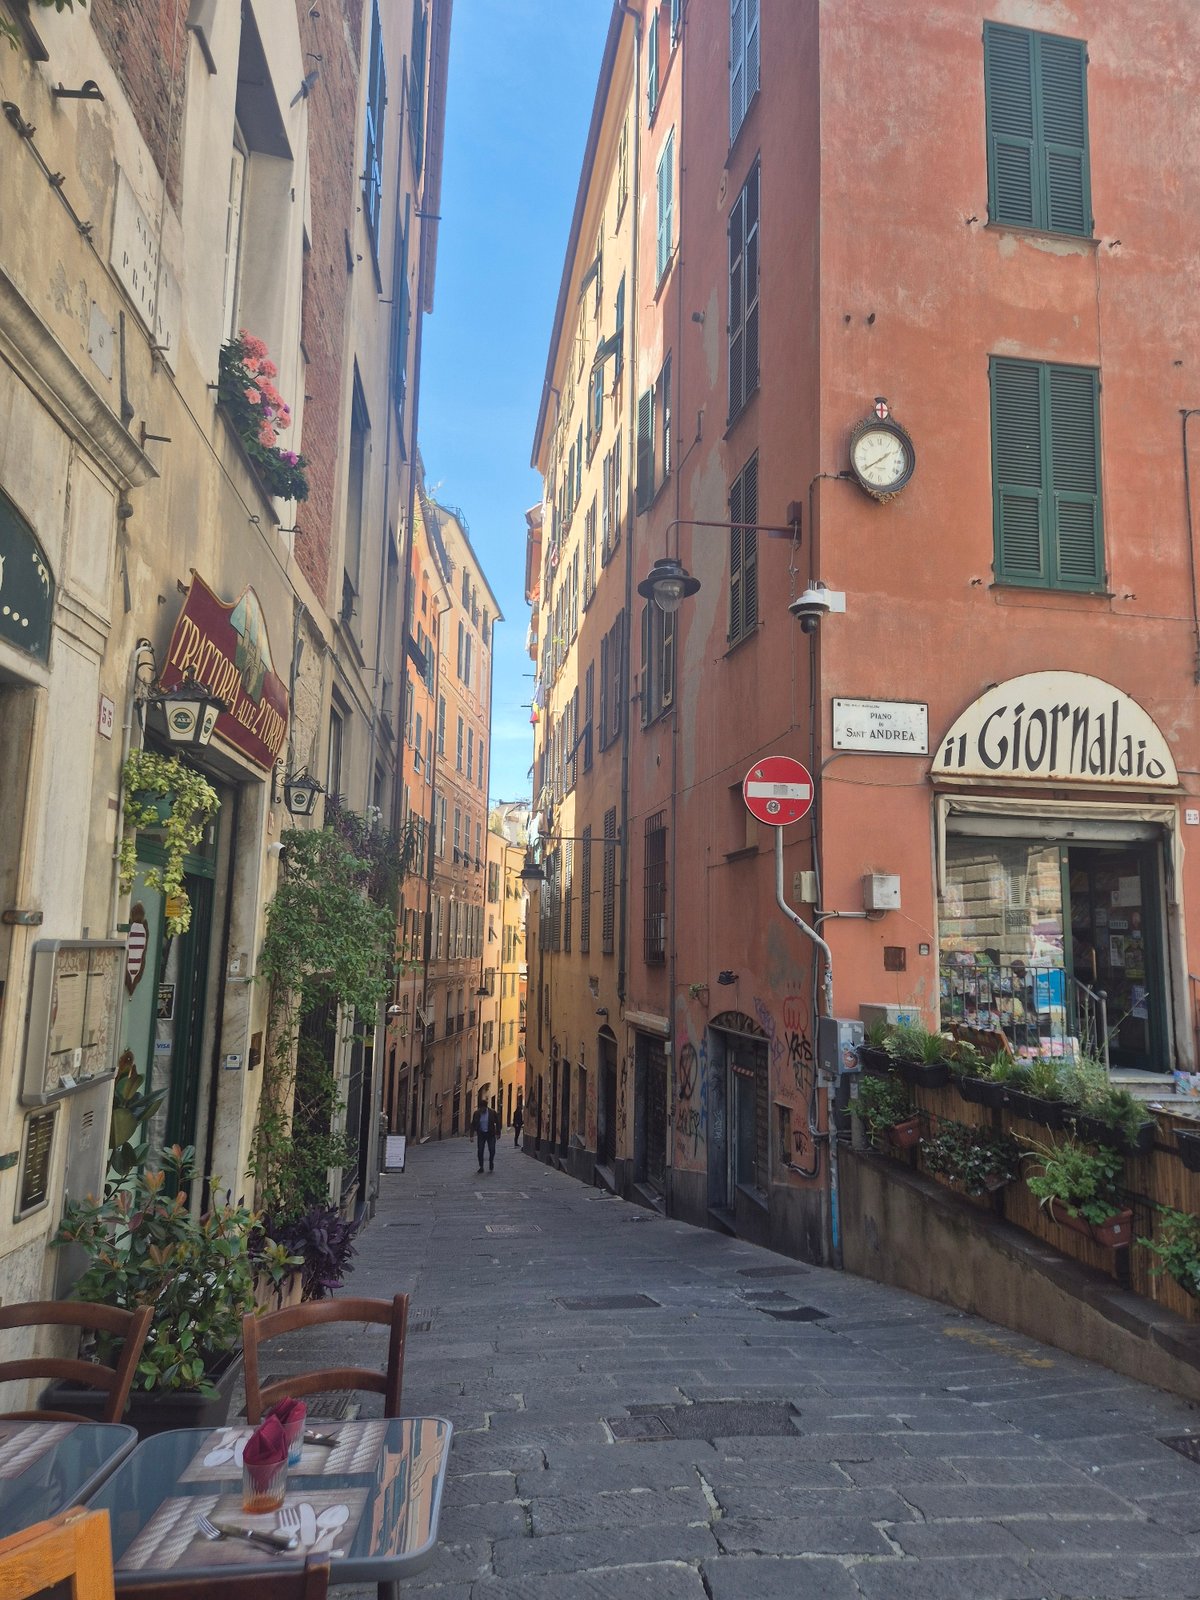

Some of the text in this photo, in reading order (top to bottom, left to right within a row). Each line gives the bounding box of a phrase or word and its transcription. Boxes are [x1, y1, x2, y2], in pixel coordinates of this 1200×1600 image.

[171, 614, 286, 757] TRATTORIA ALLE 2 TORRI
[870, 712, 892, 720] PIANO
[870, 729, 916, 742] ANDREA
[977, 700, 1167, 779] Giornalaio
